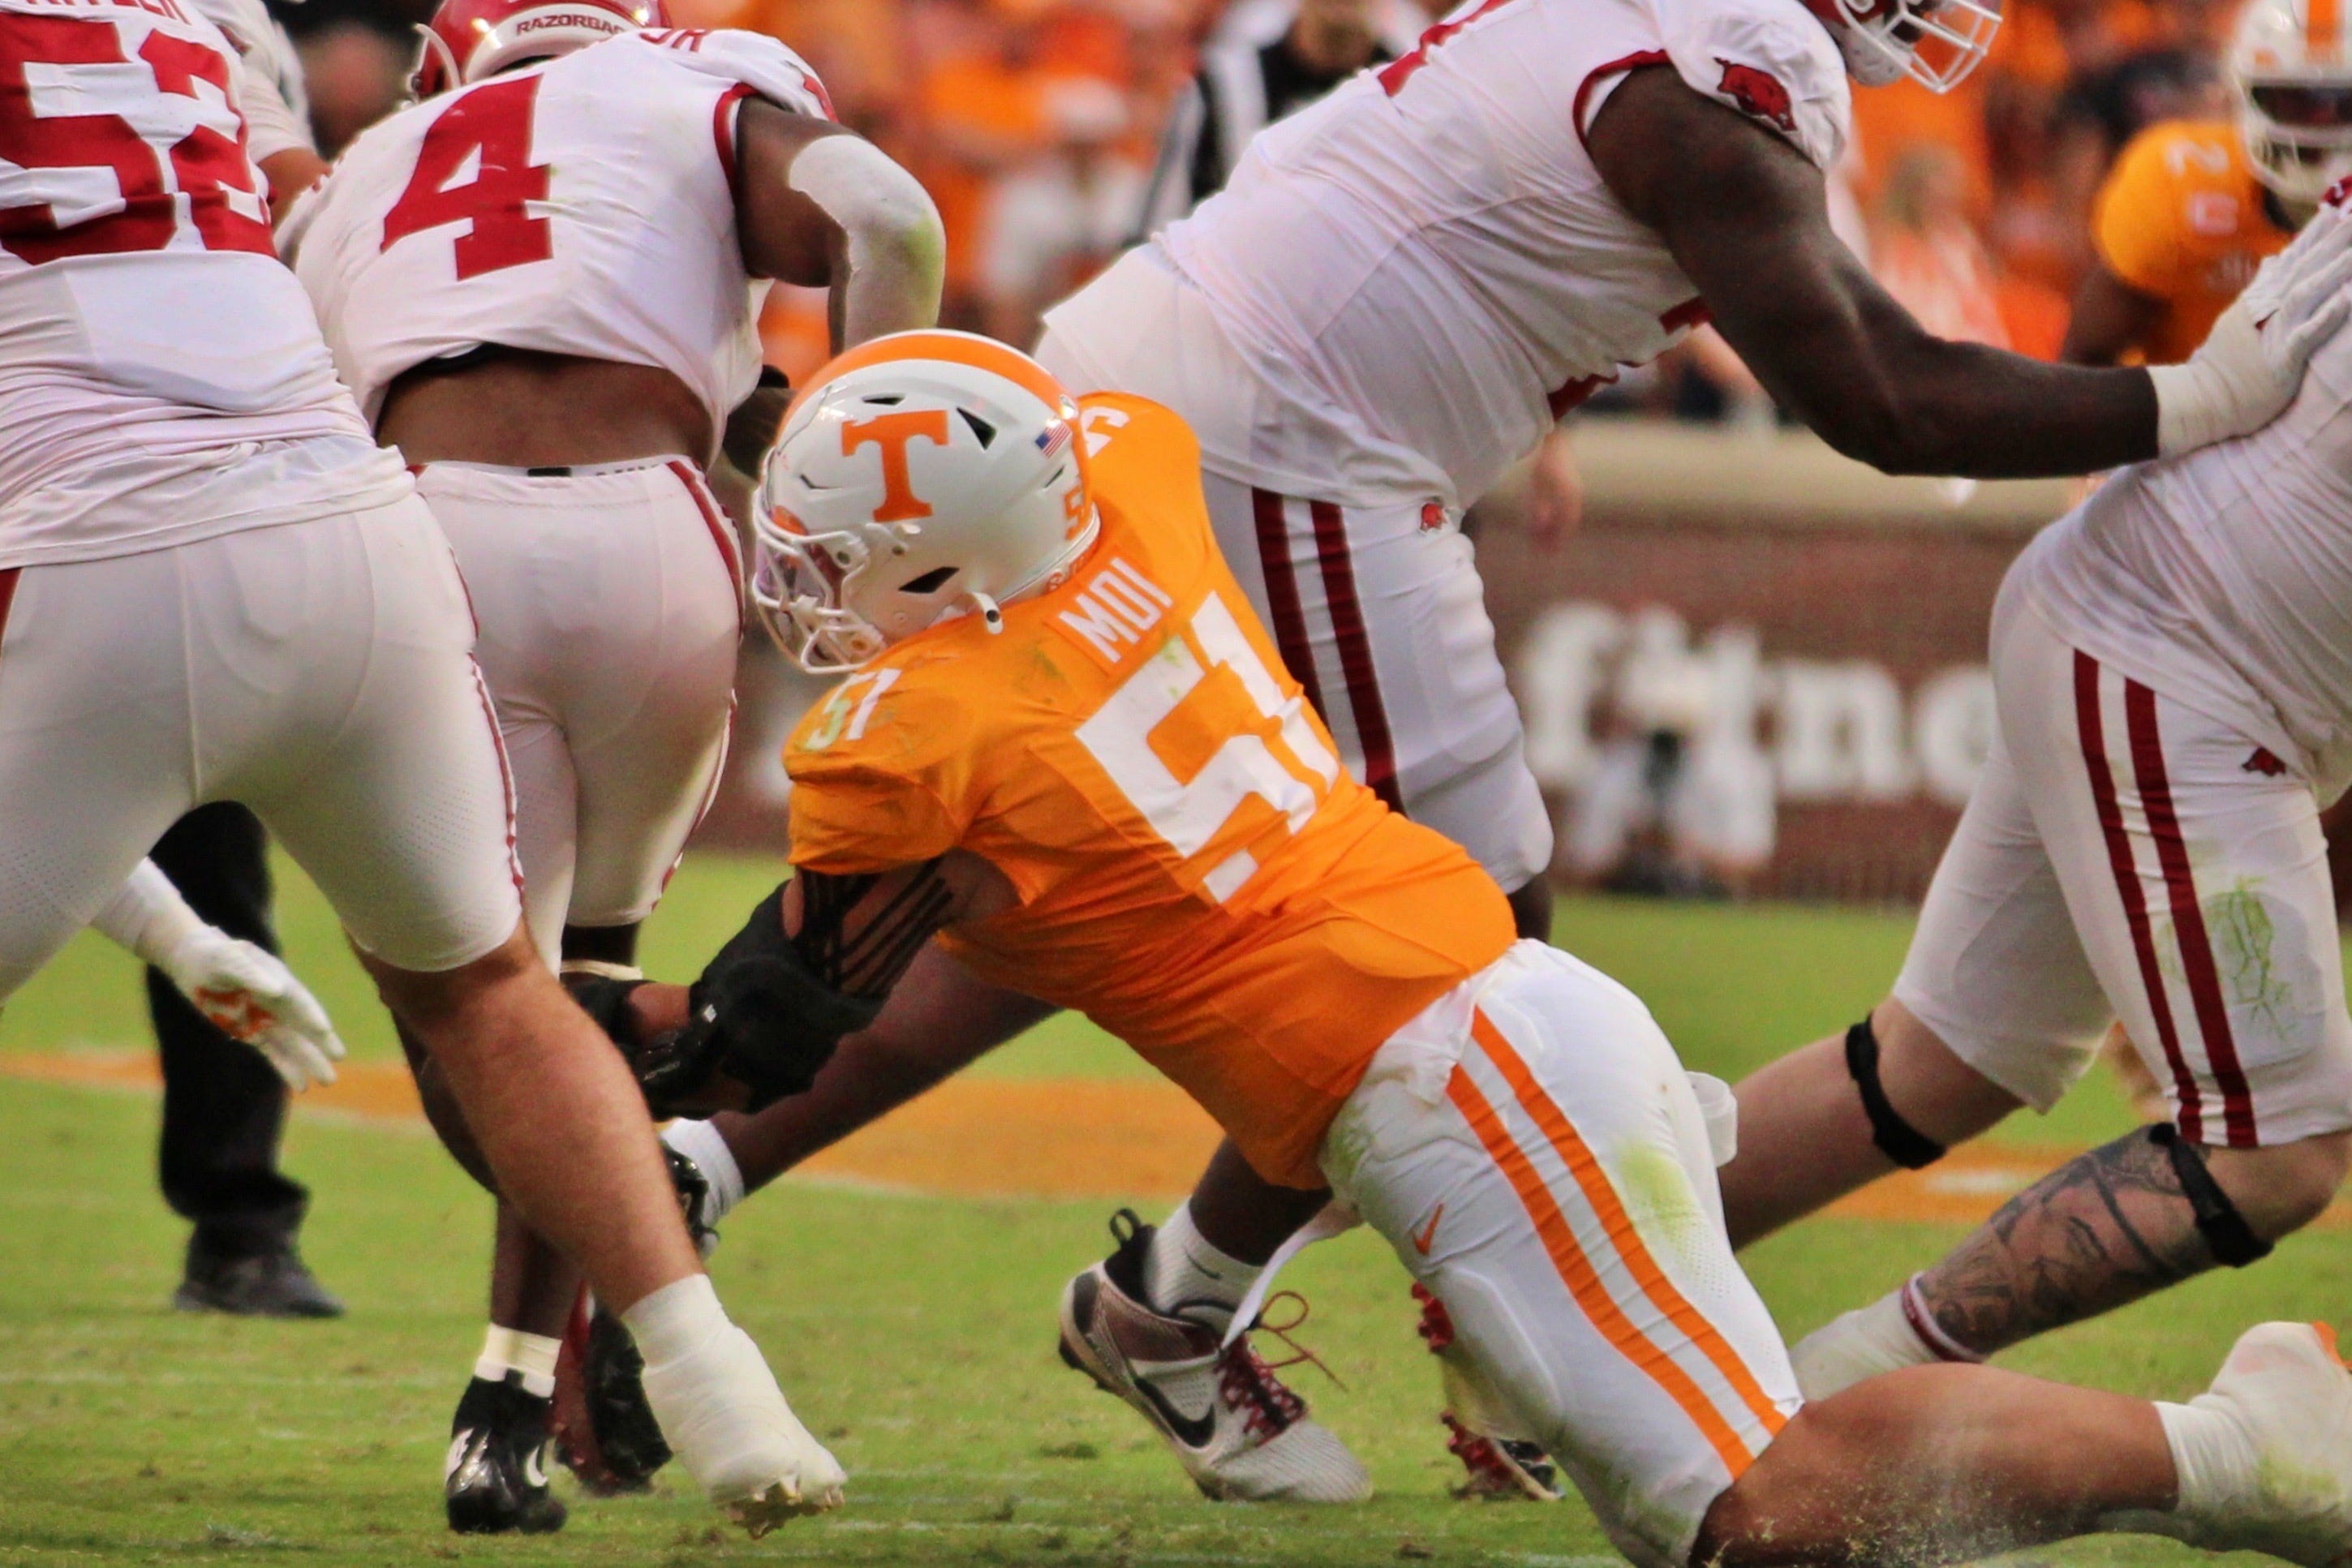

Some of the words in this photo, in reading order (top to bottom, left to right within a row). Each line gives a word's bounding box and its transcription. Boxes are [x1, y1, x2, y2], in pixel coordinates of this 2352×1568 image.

[381, 74, 553, 281] 4
[841, 410, 949, 522] T
[1059, 557, 1173, 663] MOI
